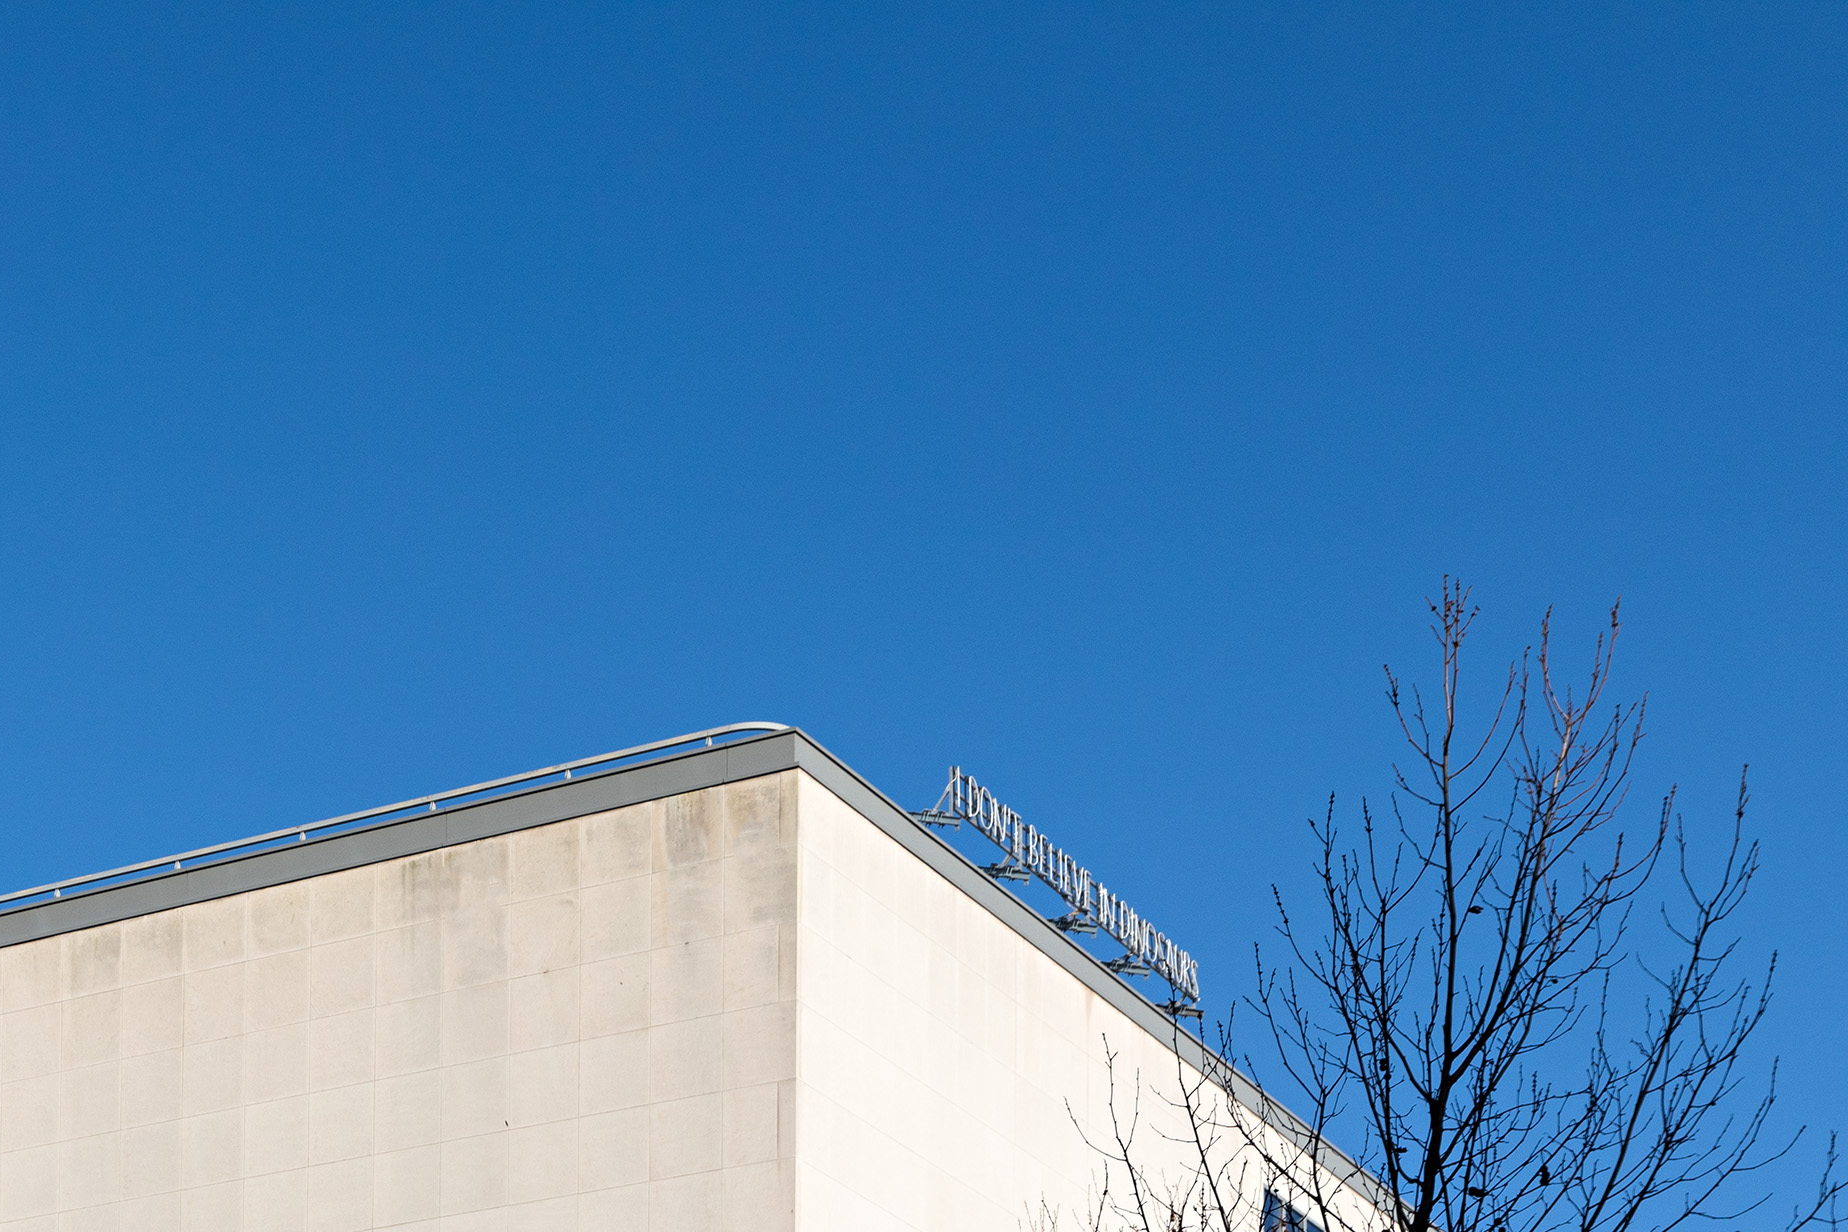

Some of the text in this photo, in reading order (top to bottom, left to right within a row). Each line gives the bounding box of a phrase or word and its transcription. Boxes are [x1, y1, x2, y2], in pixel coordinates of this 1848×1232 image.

[968, 776, 1022, 853] DON'T
[1029, 824, 1092, 911] BELIEVE
[1099, 882, 1116, 930] IN
[1120, 900, 1201, 1002] DINOSAURS
